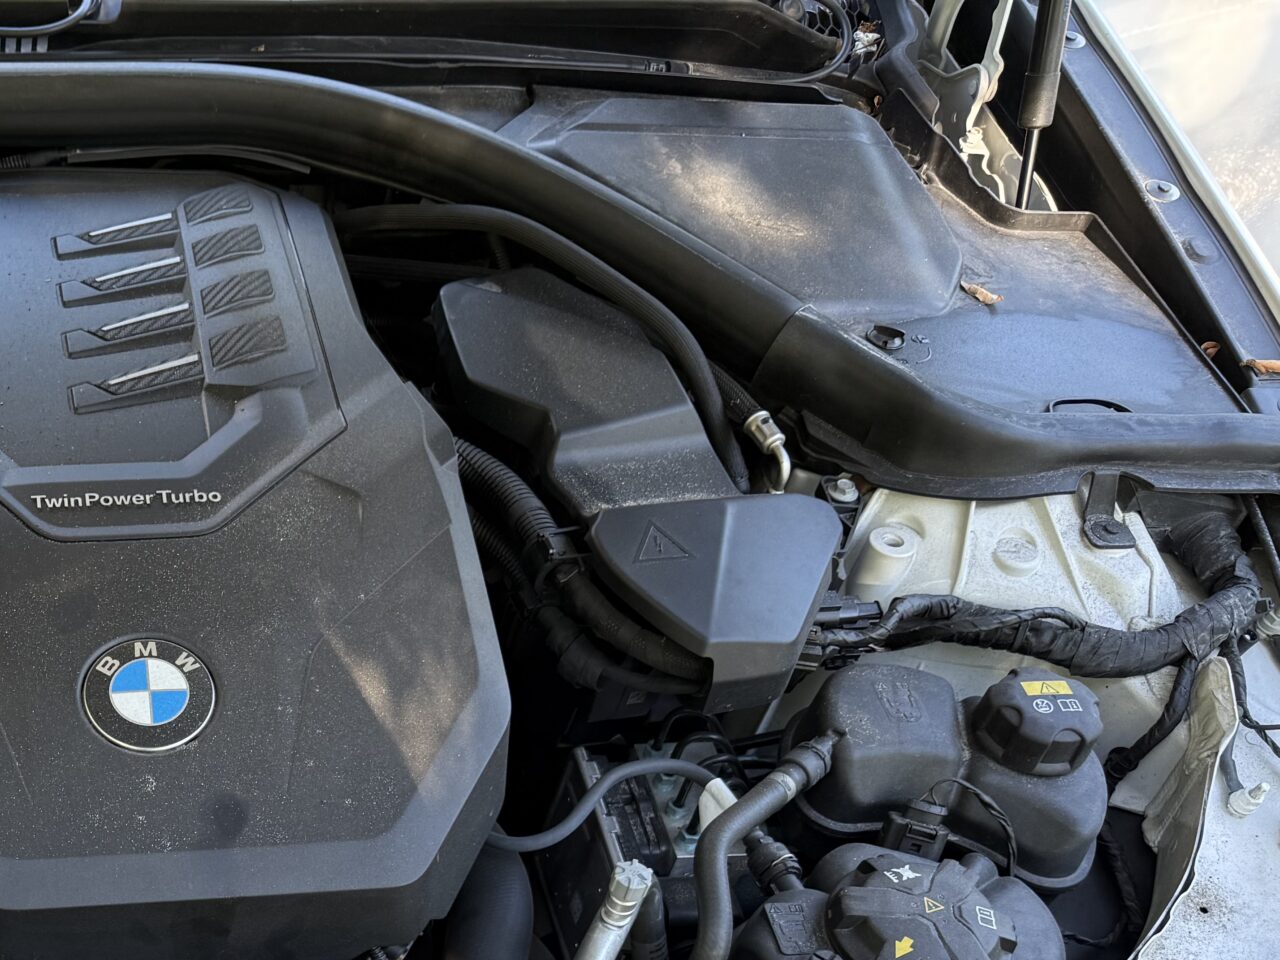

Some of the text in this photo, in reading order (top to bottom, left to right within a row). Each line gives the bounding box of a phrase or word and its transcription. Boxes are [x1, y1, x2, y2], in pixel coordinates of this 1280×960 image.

[30, 488, 222, 509] TwinPower Turbo
[95, 641, 201, 677] BMW
